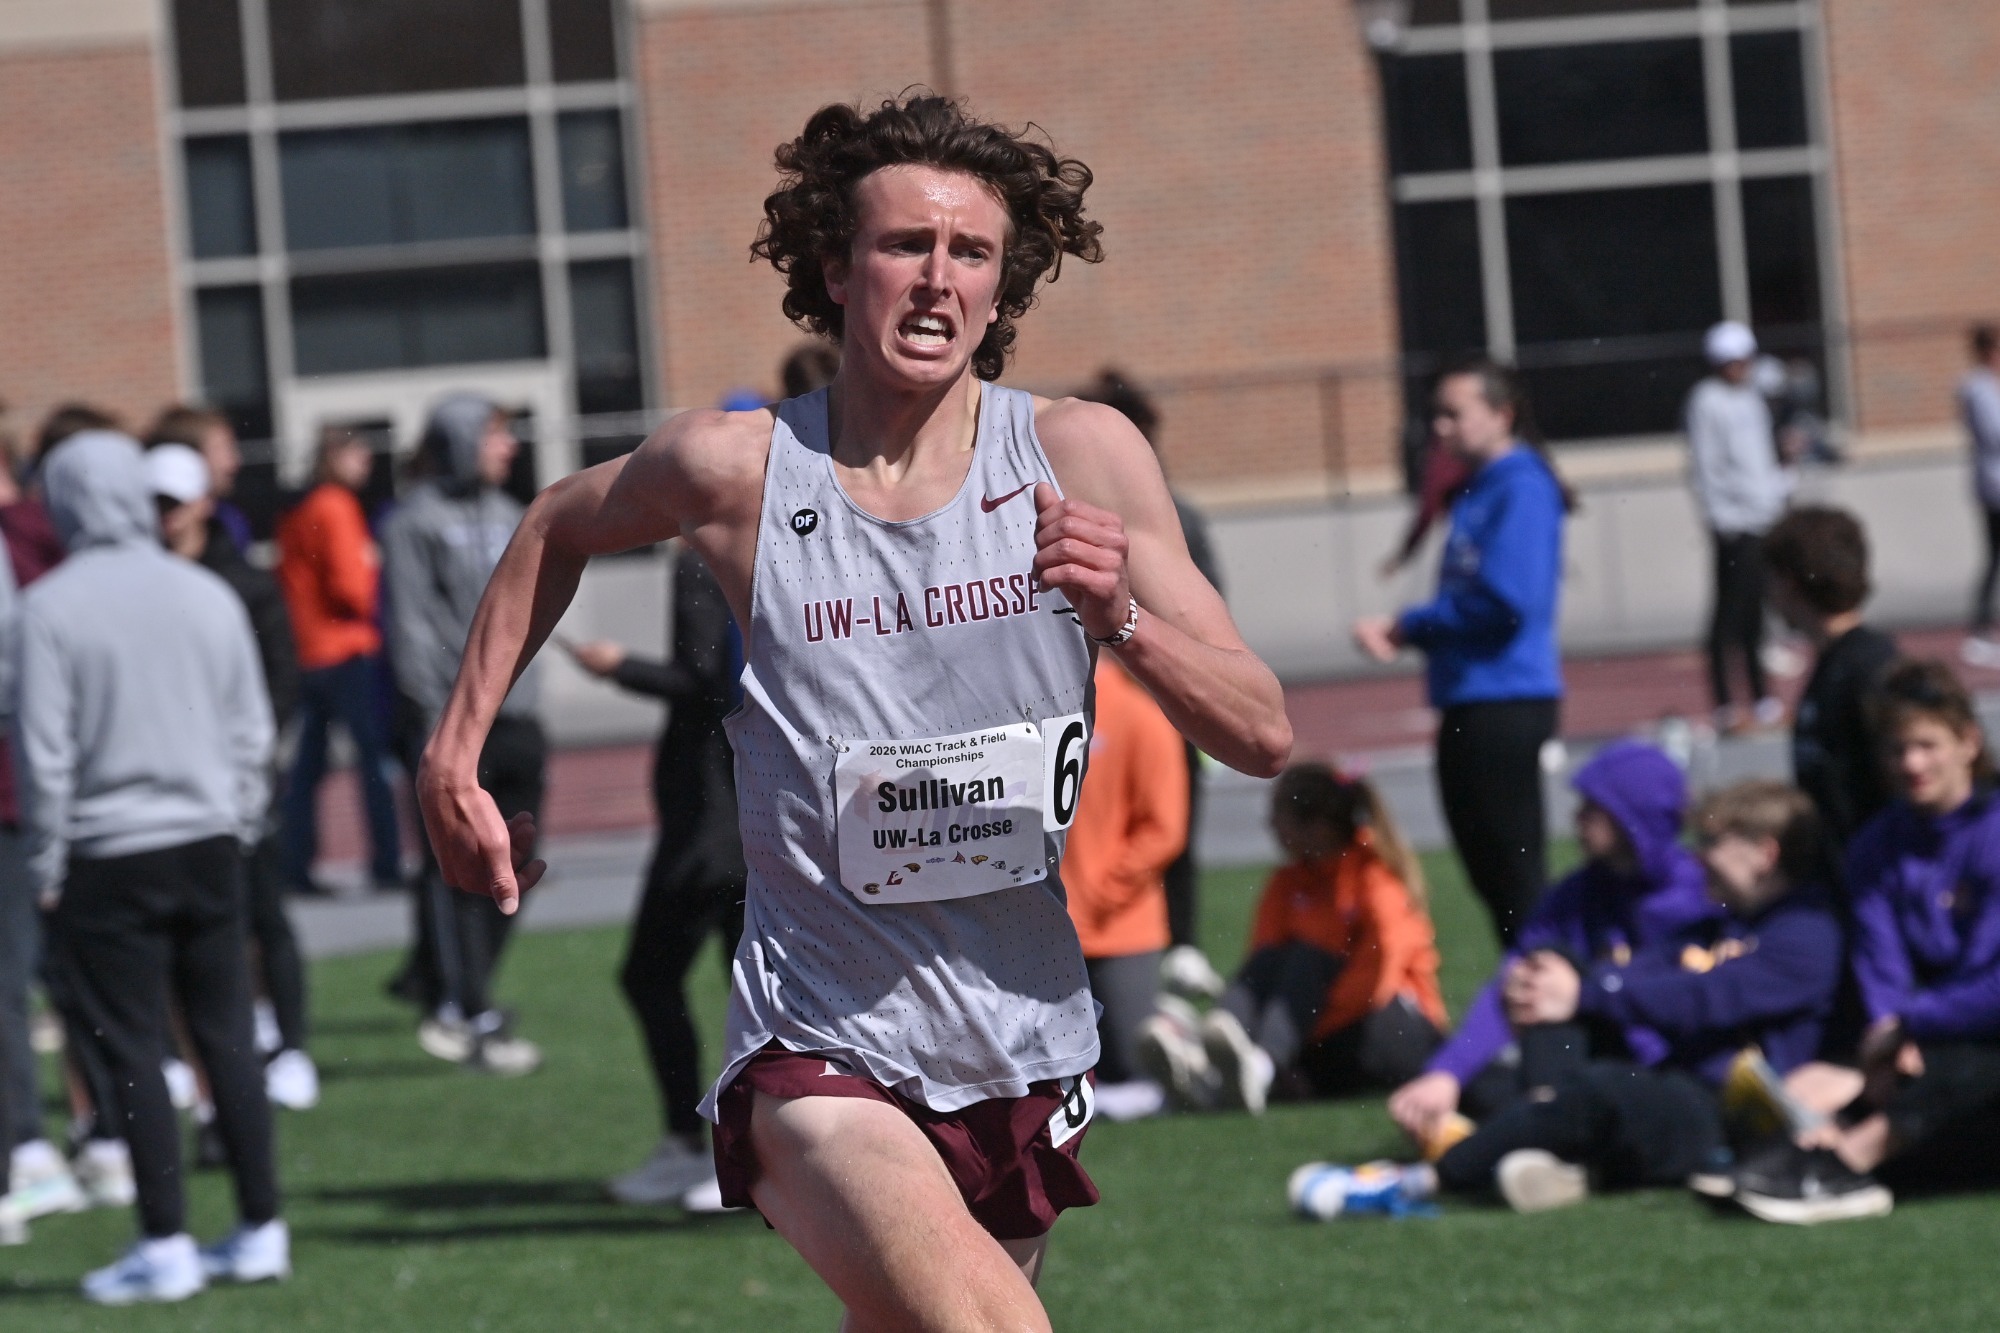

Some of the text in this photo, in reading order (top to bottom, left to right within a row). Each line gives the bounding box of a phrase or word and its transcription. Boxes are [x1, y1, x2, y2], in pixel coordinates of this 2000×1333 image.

[795, 514, 815, 529] DF
[803, 591, 915, 643] UW-LA
[869, 731, 1007, 756] 2026 WIAC Track & Field
[895, 750, 985, 769] Championships
[1053, 721, 1084, 826] 6
[877, 775, 1005, 813] Sullivan
[873, 819, 1013, 849] UW-La Crosse
